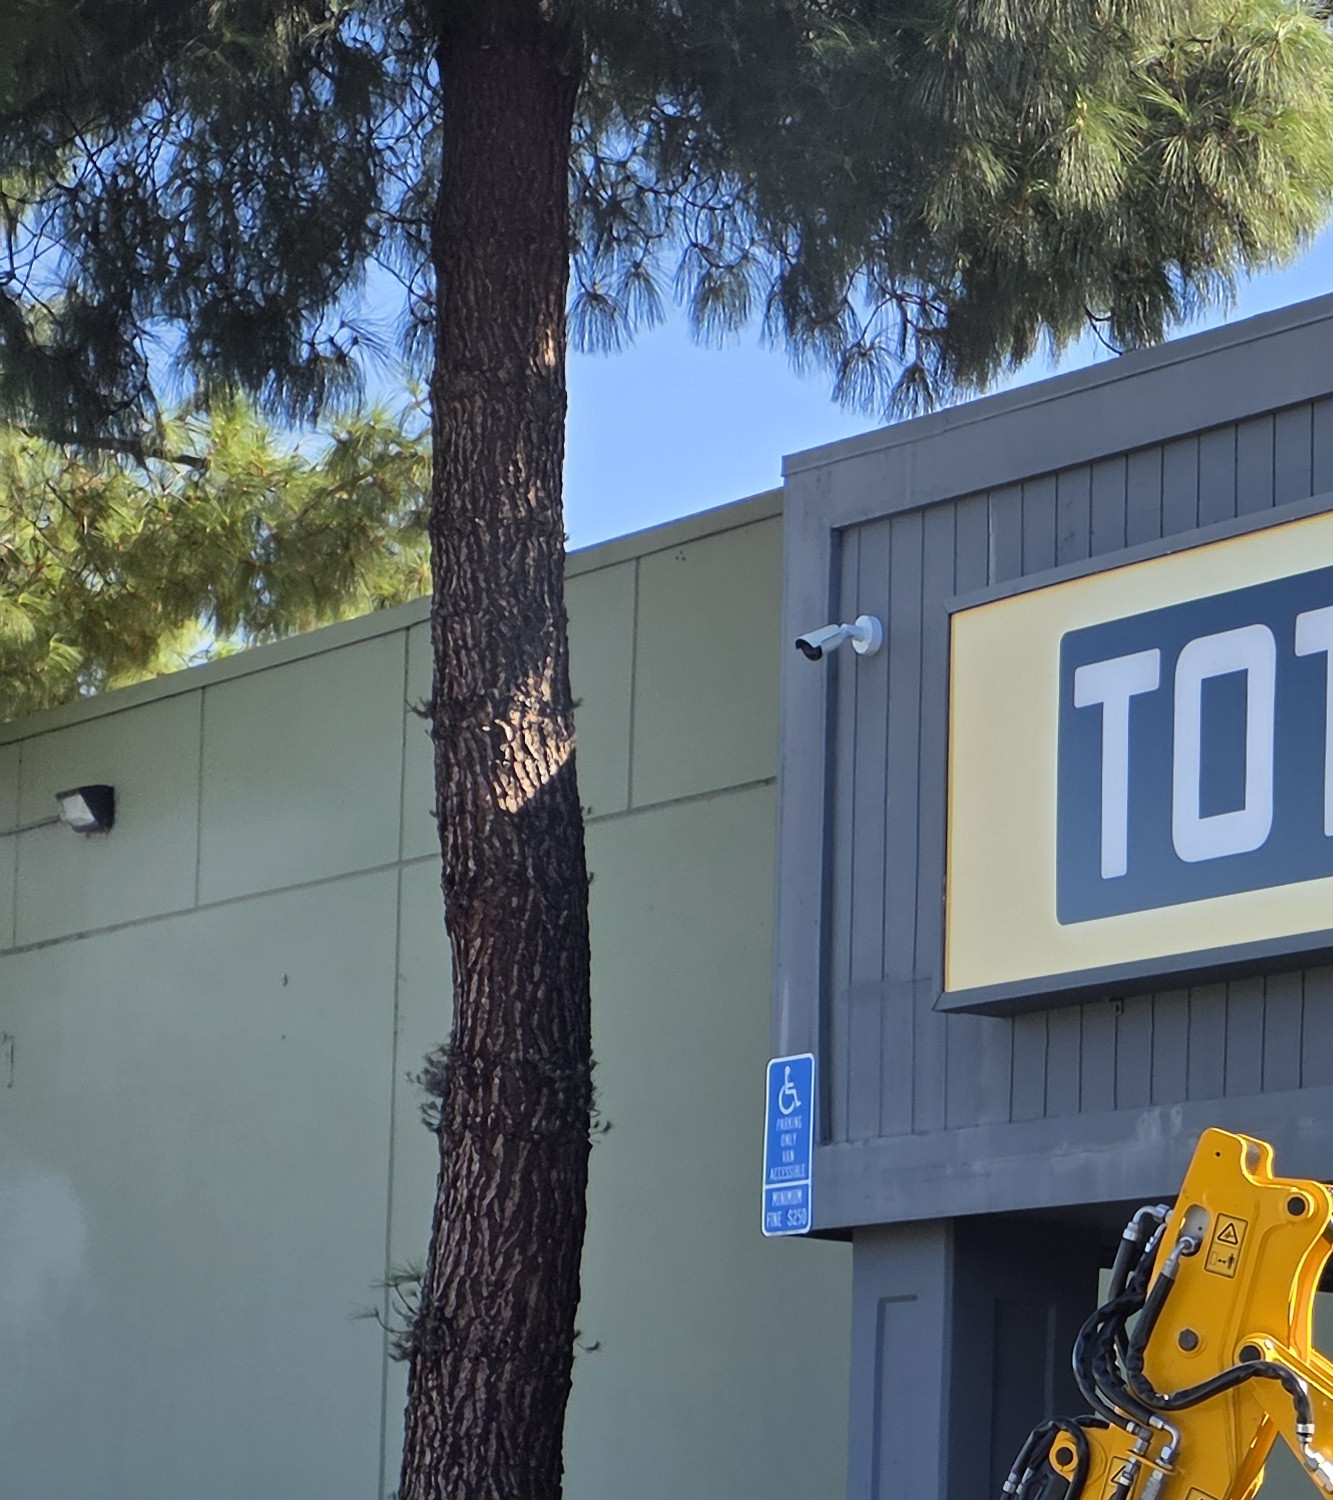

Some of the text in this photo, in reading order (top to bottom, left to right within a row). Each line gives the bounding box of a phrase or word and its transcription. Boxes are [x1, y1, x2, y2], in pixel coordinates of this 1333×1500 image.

[776, 1115, 803, 1131] PARKING
[780, 1133, 797, 1147] ONLY
[770, 1163, 806, 1180] ACCESSIBLE
[772, 1189, 802, 1206] MINIMUM
[766, 1207, 808, 1228] FINE $250
